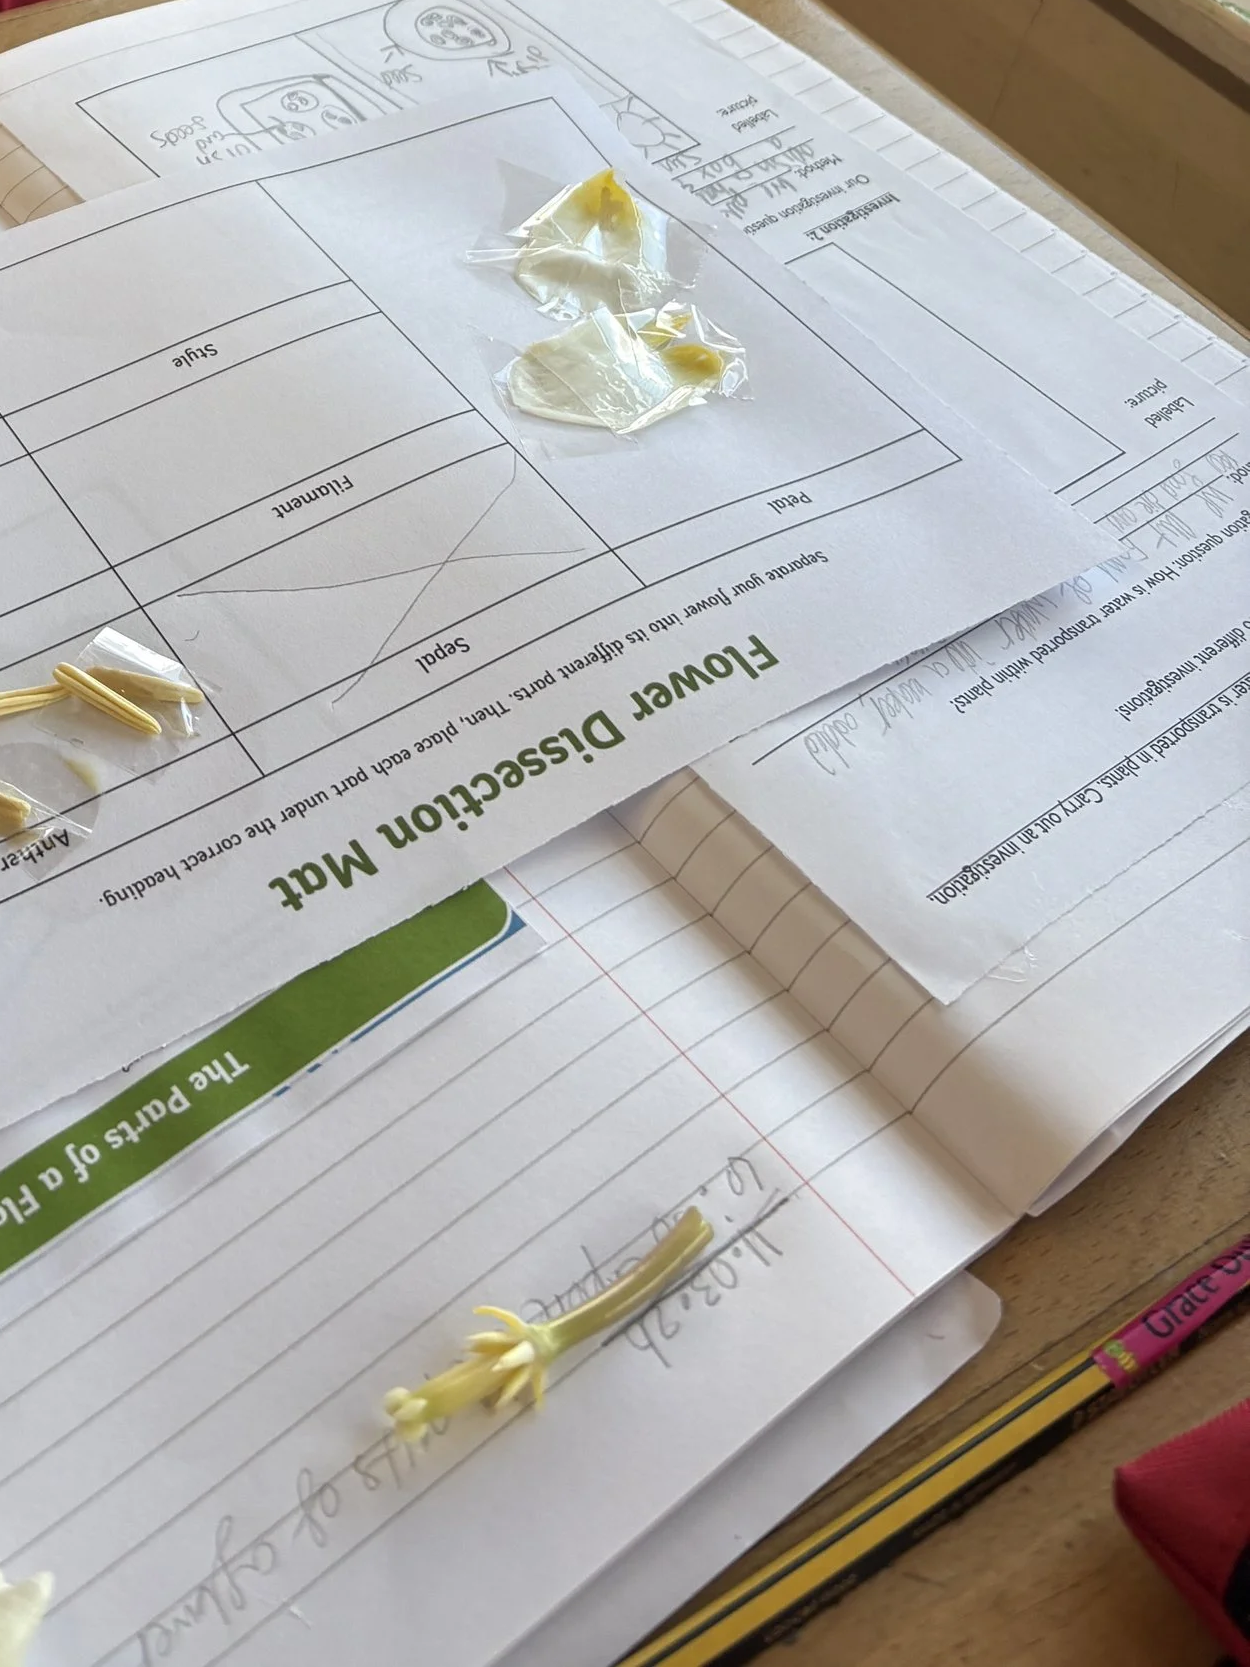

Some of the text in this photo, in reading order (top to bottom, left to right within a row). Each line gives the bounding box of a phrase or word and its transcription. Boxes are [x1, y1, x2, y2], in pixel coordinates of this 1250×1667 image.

[729, 108, 778, 132] Labelled
[792, 152, 842, 180] Method:
[845, 172, 870, 189] Our
[777, 181, 845, 218] investigation
[804, 193, 900, 241] Investigation 2:
[169, 339, 218, 371] Style
[1123, 377, 1167, 408] picture:
[1143, 395, 1194, 427] Labelled
[270, 473, 354, 520] Filament
[766, 490, 812, 514] Petal
[1170, 533, 1222, 570] question:
[1130, 583, 1147, 597] is
[1143, 564, 1178, 588] How
[1098, 591, 1135, 617] water
[414, 635, 470, 672] Sepal
[1028, 612, 1100, 664] transported
[990, 656, 1033, 683] within
[1113, 628, 1245, 721] different investigations!
[947, 675, 993, 713] plants?
[1217, 693, 1233, 707] is
[97, 550, 827, 908] Separate your flower into its different parts. Then, place each part under the correct heading.
[1148, 701, 1222, 757] transported
[1096, 754, 1139, 788] plants.
[1135, 746, 1153, 765] in
[267, 634, 778, 910] Flower Dissection Mat
[1056, 785, 1103, 816] Carry
[1016, 827, 1037, 846] an
[1032, 811, 1061, 834] out
[927, 840, 1021, 905] investigation.
[187, 1049, 249, 1091] The
[102, 1084, 190, 1148] Parts
[63, 1141, 100, 1182] of
[36, 1166, 63, 1190] a
